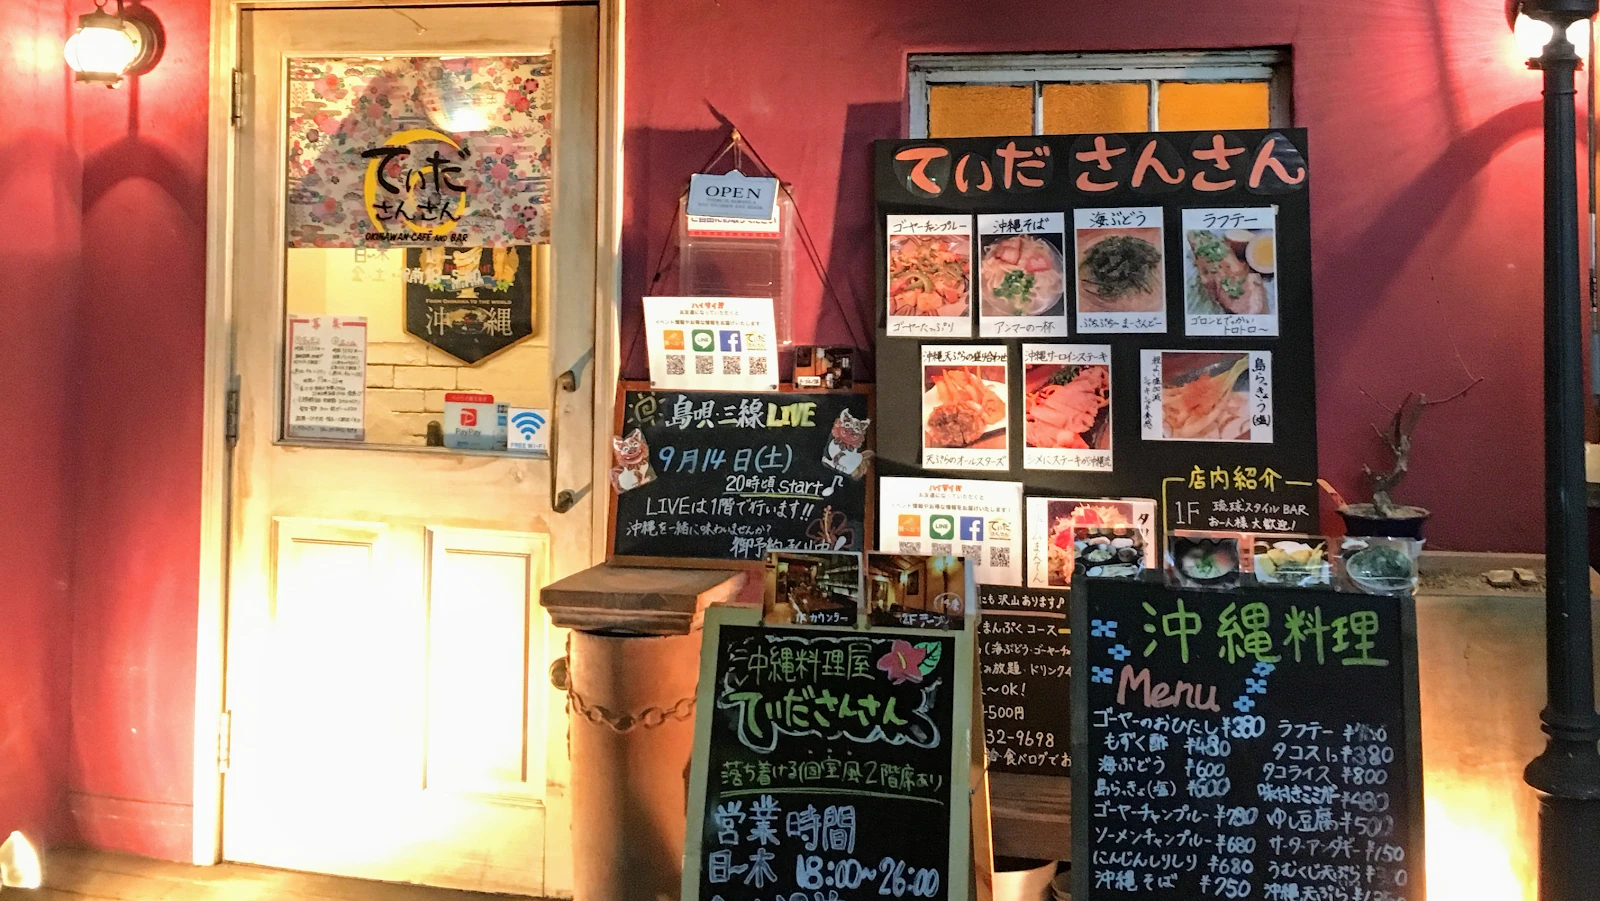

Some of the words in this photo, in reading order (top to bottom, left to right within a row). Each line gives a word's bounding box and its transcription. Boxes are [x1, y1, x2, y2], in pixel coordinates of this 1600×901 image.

[1075, 133, 1306, 192] さんさん
[706, 185, 762, 199] OPEN
[372, 201, 461, 221] さんさん
[1090, 211, 1147, 228] 海ぶどう
[1202, 212, 1258, 228] ラフテー
[893, 219, 967, 233] ゴーヤーチャンプルー
[992, 218, 1050, 233] 沖縄そば
[451, 233, 469, 242] BAR
[893, 321, 954, 333] ゴーヤーたっぷり
[994, 321, 1056, 334] アンマーの一杯
[923, 350, 1008, 363] 沖縄天ぷらの盛り合わせ
[1024, 350, 1108, 363] 沖縄サーロインステーキ
[455, 428, 482, 437] PayPay
[925, 454, 1006, 467] 天ぷらのオールスターズ
[1188, 464, 1283, 492] 店内紹介
[1175, 501, 1200, 525] 1F
[1143, 598, 1389, 667] 沖縄料理
[1117, 663, 1221, 712] Menu
[1093, 706, 1219, 735] ゴーヤーのおひたし
[1277, 719, 1334, 740] ラフテー
[1104, 731, 1169, 752] もずく酢
[1183, 734, 1232, 757] ¥480
[1098, 754, 1166, 776] 海ぶどう
[1184, 757, 1226, 778] ¥600
[1263, 761, 1332, 784] タコライス
[1341, 766, 1388, 785] ¥800
[1257, 782, 1341, 805] 味付きミミガー
[714, 793, 856, 853] 営業時間
[1093, 799, 1209, 824] ゴーヤーチャンプルー
[1095, 826, 1212, 848] ソーメンチャンプルー
[1215, 833, 1257, 854] ¥680
[1093, 850, 1198, 871] にんじんしりしり
[1207, 854, 1254, 875] ¥680
[1268, 860, 1361, 883] うむくじ天ぷら
[1095, 869, 1178, 892] 沖縄そば
[1199, 874, 1252, 899] ¥750
